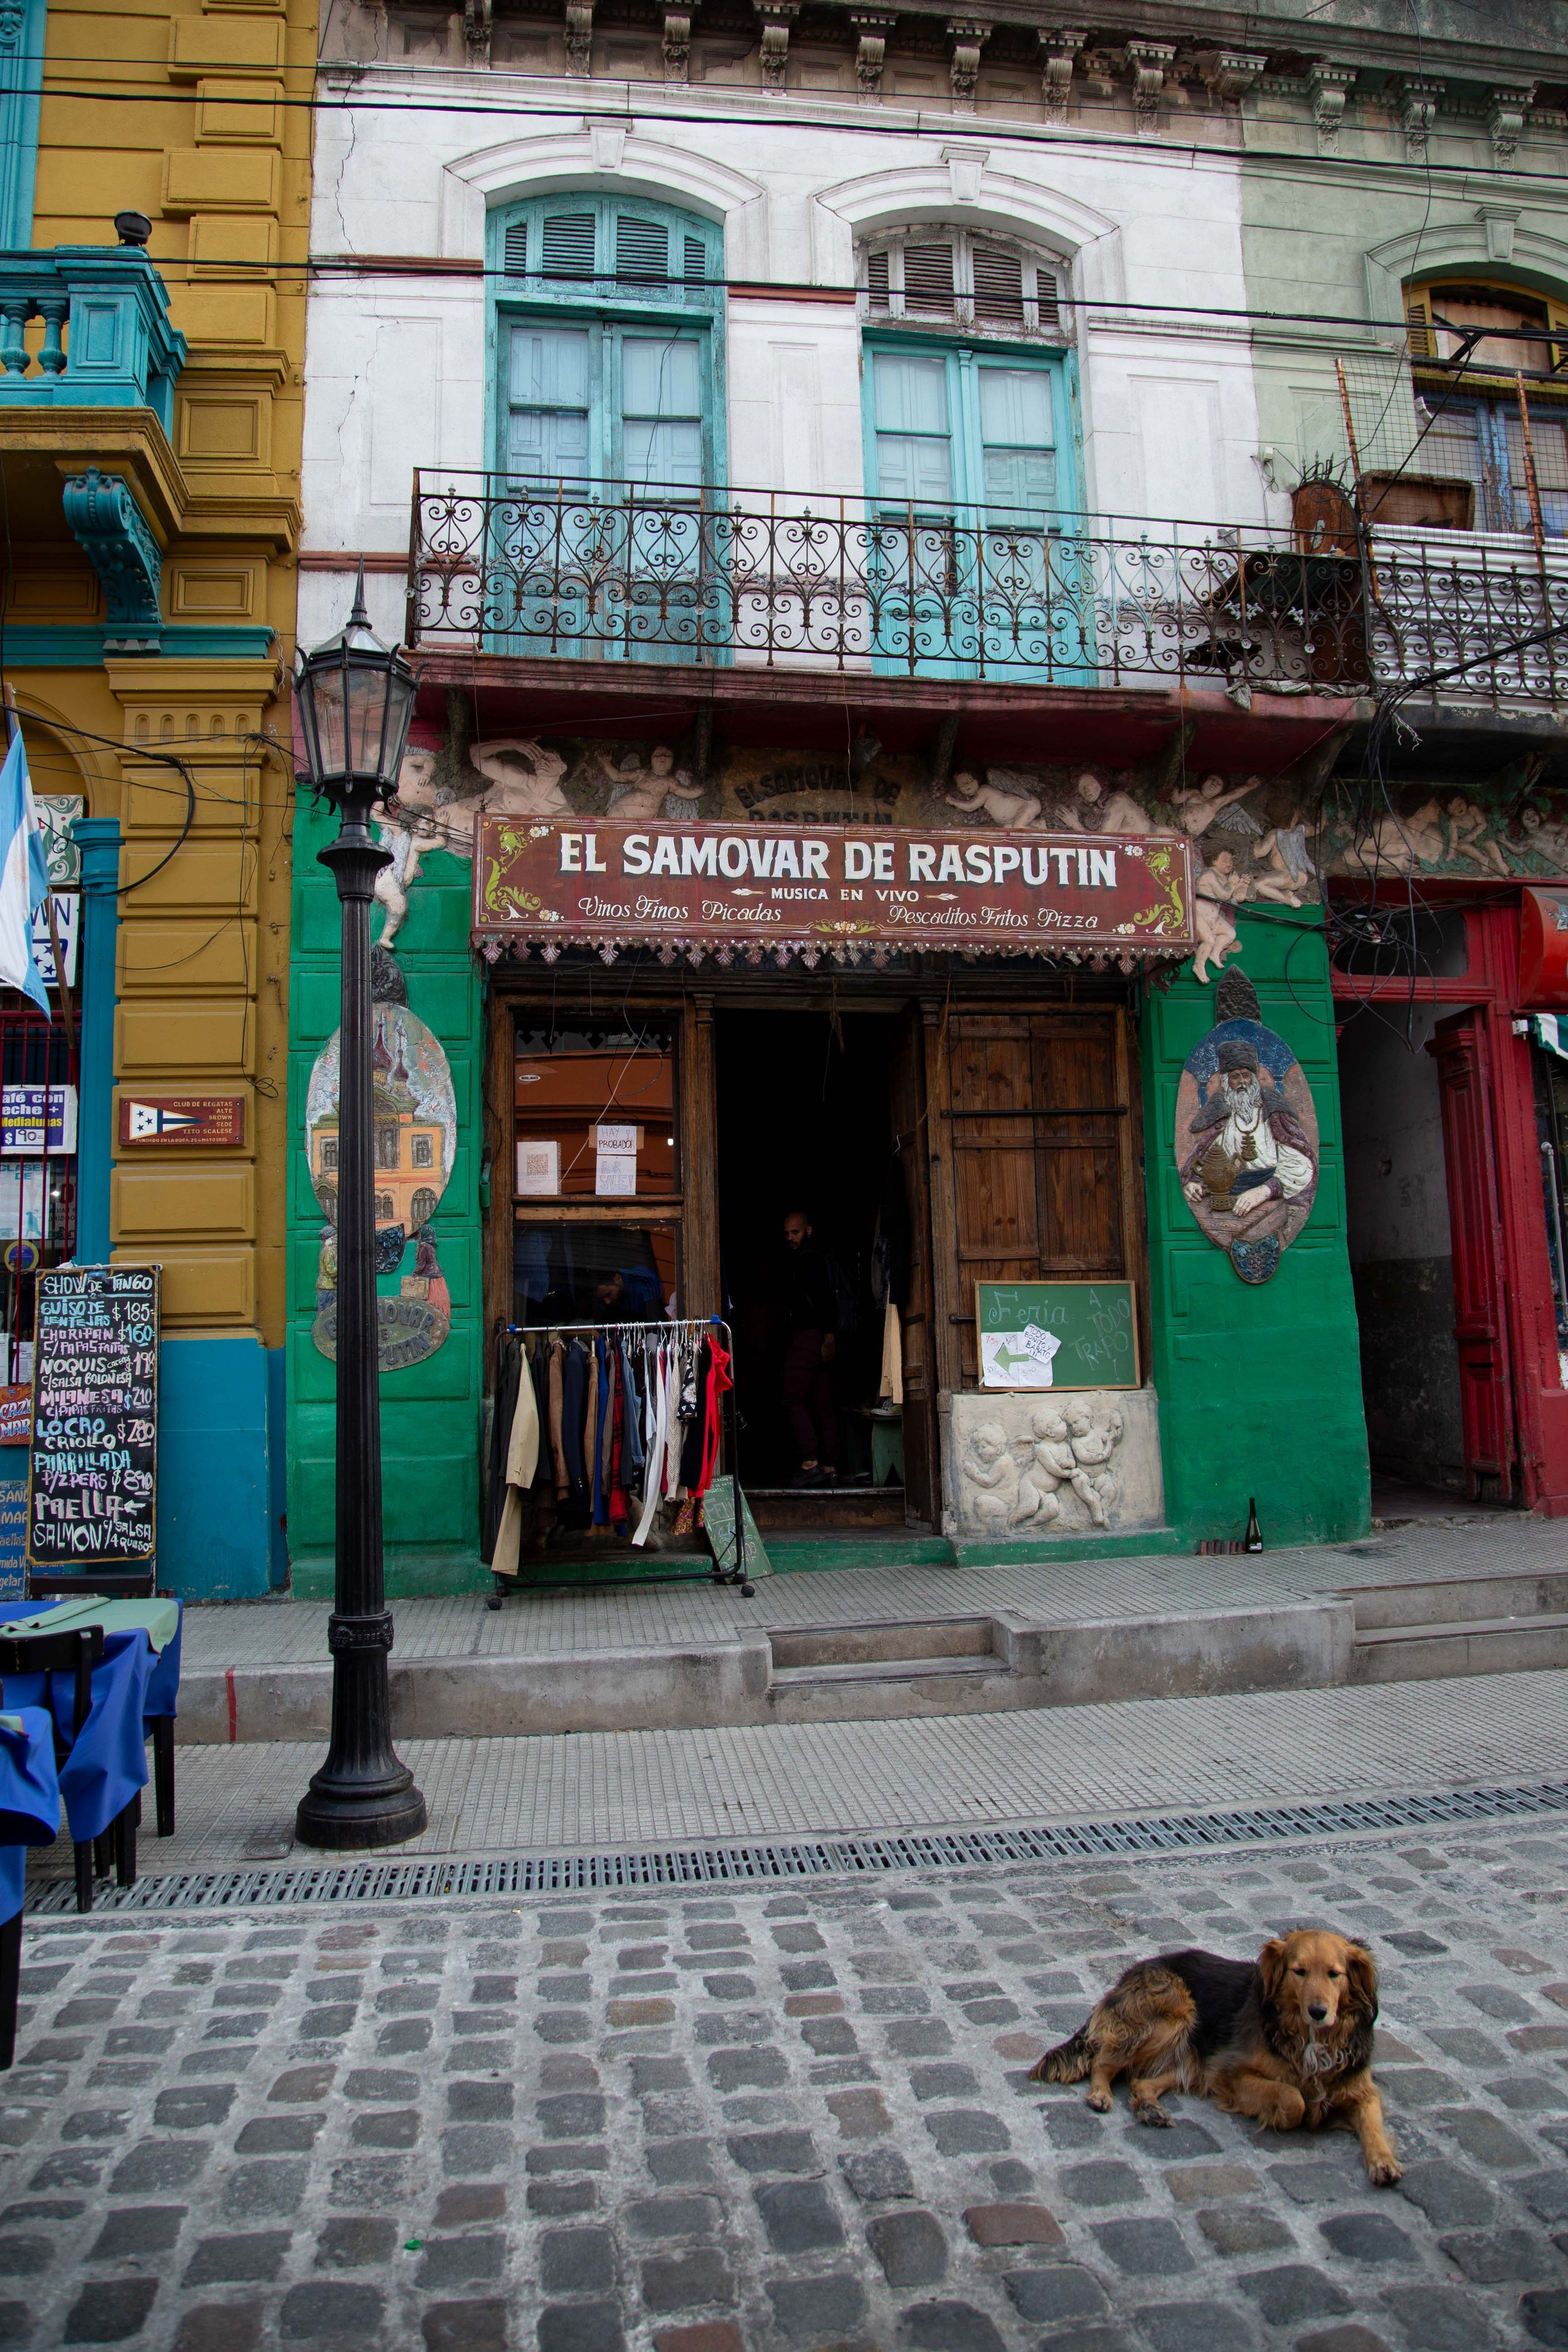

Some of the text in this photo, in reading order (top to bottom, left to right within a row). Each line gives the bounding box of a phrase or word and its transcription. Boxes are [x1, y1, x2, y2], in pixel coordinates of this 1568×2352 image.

[560, 834, 1118, 888] EL SAMOVAR DE RASPUTIN
[771, 888, 920, 903] MUSICA EN VIVO
[578, 894, 782, 922] Vinos Finos Picadas
[886, 905, 1099, 930] Pescaditos Fritos Pizza
[601, 1127, 620, 1137] HAY
[598, 1139, 635, 1149] PROBADOR
[601, 1161, 622, 1174] FOR
[43, 1273, 153, 1294] SHOW DE TANGO
[40, 1298, 86, 1316] GUISO
[88, 1300, 105, 1314] DE
[988, 1291, 1069, 1325] Feria
[44, 1315, 111, 1329] LENTEJAS
[40, 1327, 114, 1342] CHORIPAN
[1024, 1331, 1046, 1348] BONITO
[1029, 1325, 1046, 1340] TODO
[97, 1341, 130, 1355] FRITAS
[1025, 1340, 1051, 1359] BARATO
[40, 1355, 108, 1376] ÑOQUIS
[40, 1387, 123, 1406] MILANESA
[89, 1404, 123, 1415] FRITAS
[36, 1417, 106, 1438] LOCRO
[45, 1432, 116, 1450] CRIOLLO
[33, 1450, 132, 1473] PARRILLADA
[34, 1489, 125, 1524] PAELLA
[33, 1520, 103, 1553] SALMON
[115, 1520, 152, 1541] SALSA
[110, 1533, 119, 1547] 4
